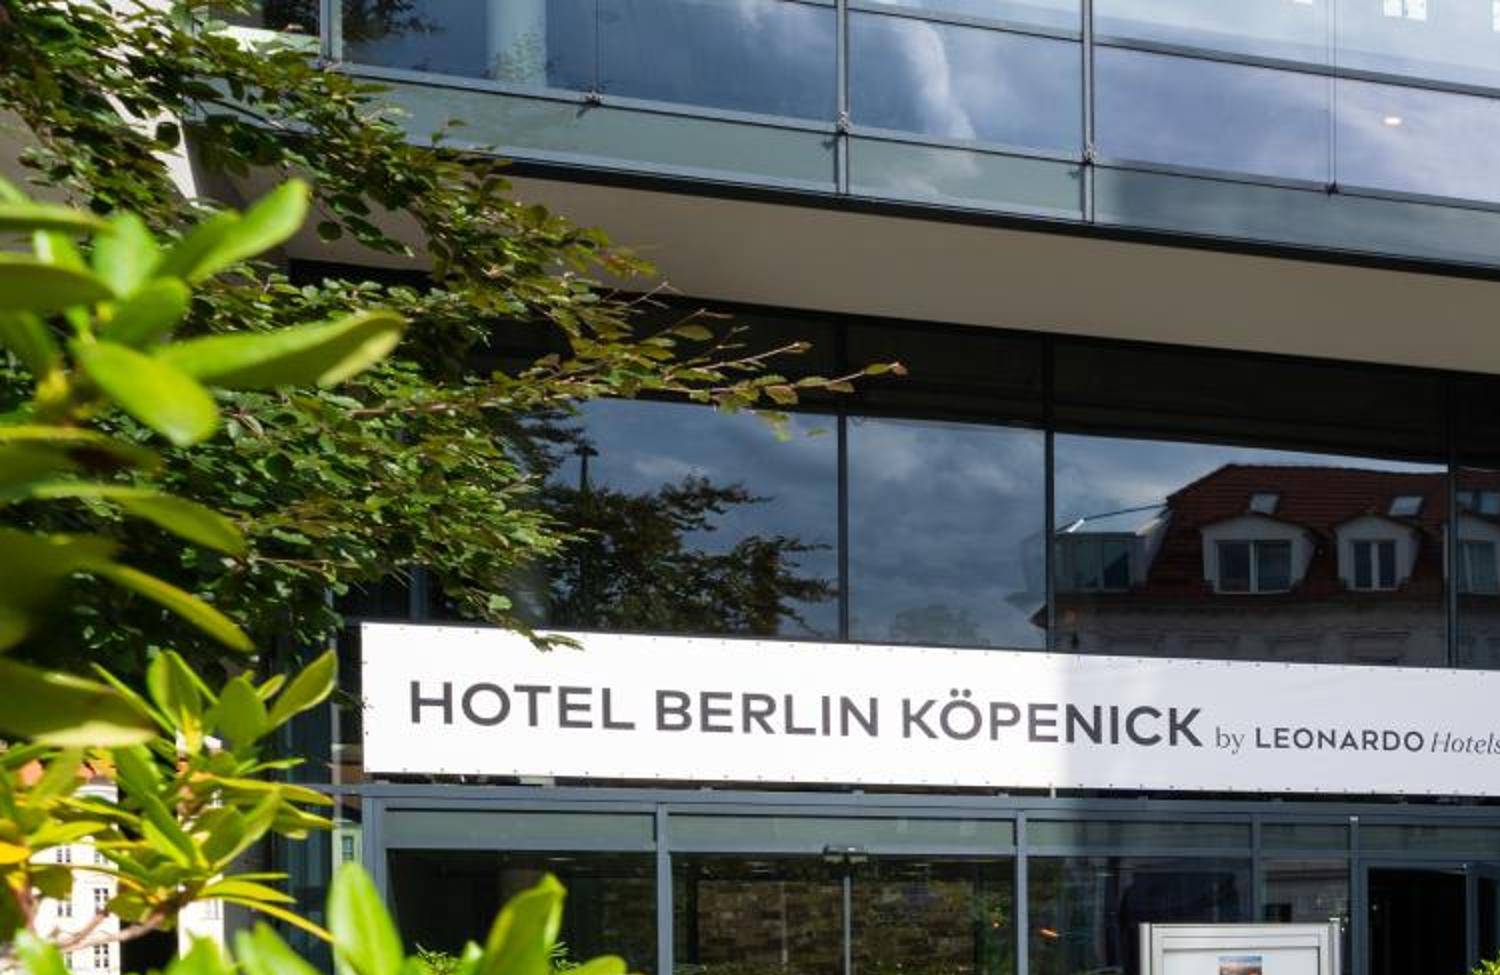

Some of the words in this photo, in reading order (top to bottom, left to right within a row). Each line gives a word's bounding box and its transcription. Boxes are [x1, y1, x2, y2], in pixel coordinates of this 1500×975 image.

[410, 680, 636, 731] HOTEL
[655, 689, 879, 737] BERLIN
[902, 688, 1203, 748] KÖPENICK
[1215, 726, 1246, 755] by
[1255, 727, 1425, 753] LEONARDO
